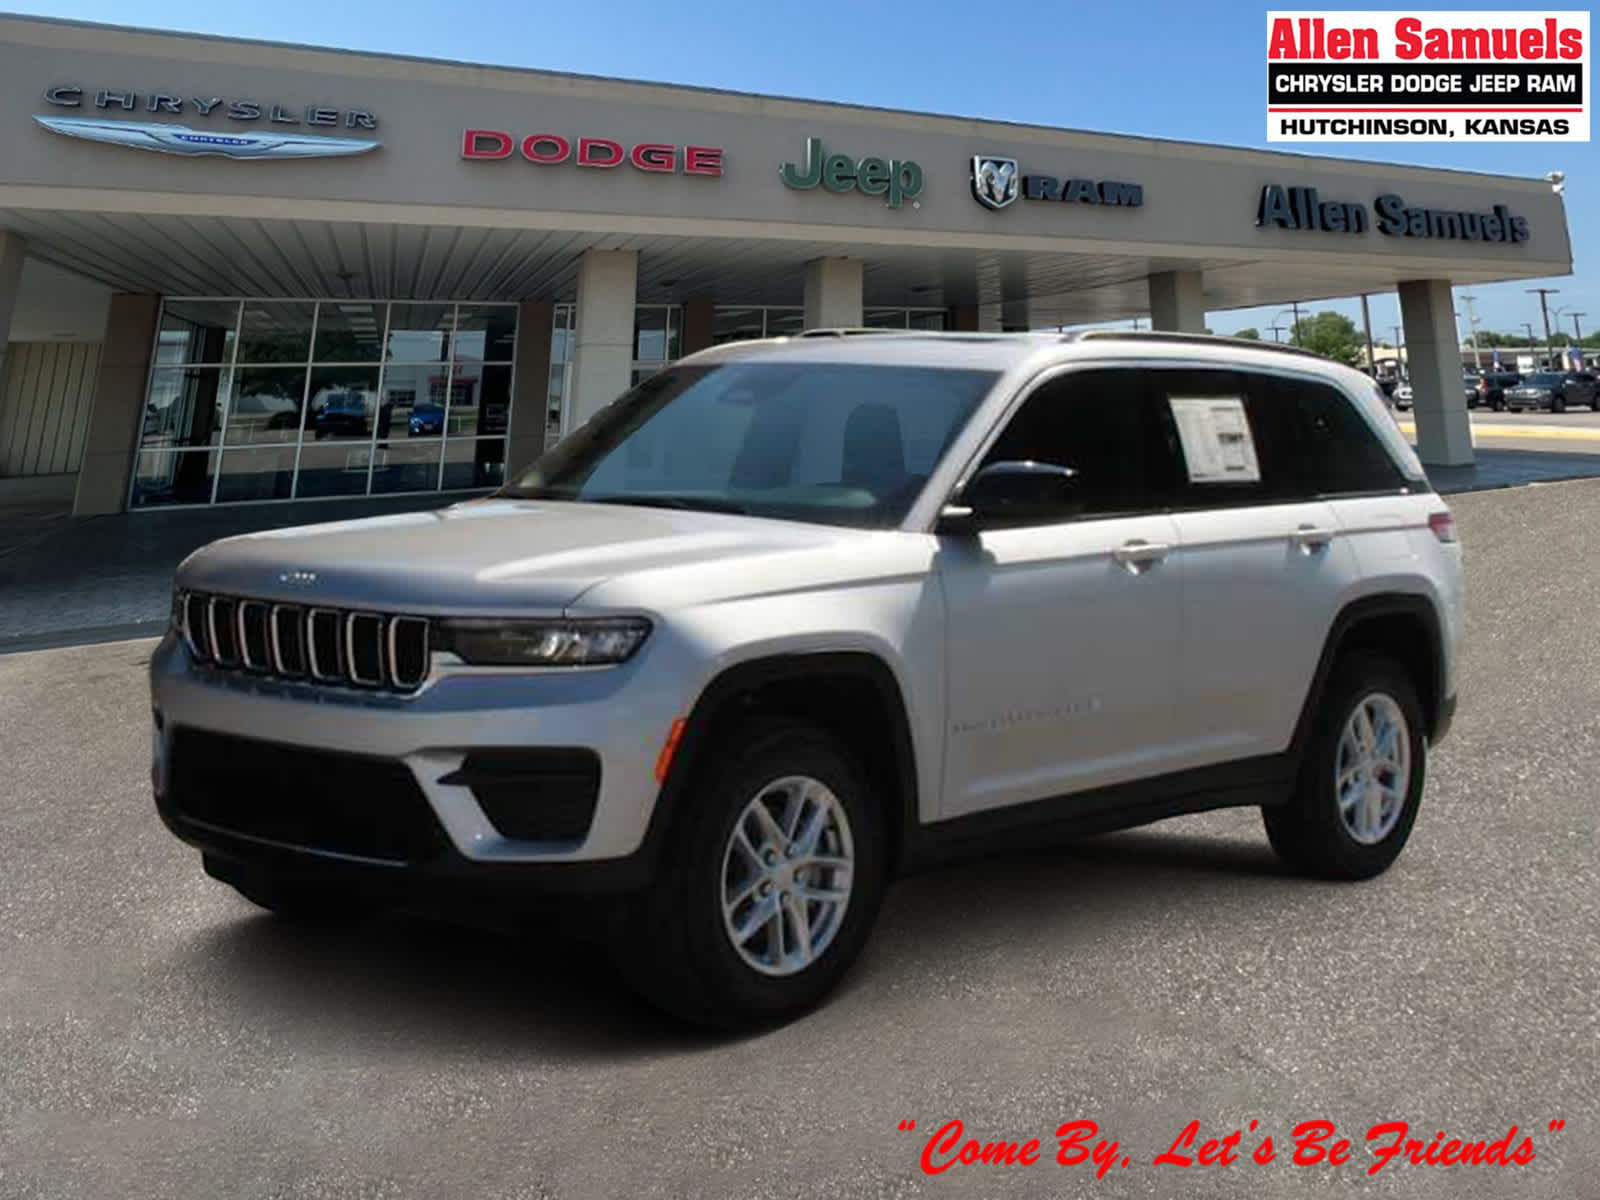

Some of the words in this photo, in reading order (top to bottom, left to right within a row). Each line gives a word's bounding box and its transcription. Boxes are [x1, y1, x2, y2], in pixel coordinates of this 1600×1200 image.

[43, 86, 378, 130] CHRYSLER
[462, 128, 725, 177] DODGE
[779, 136, 925, 210] Jeep
[1023, 175, 1144, 207] RAM
[1257, 184, 1369, 233] Allen
[1374, 194, 1530, 244] Samuels
